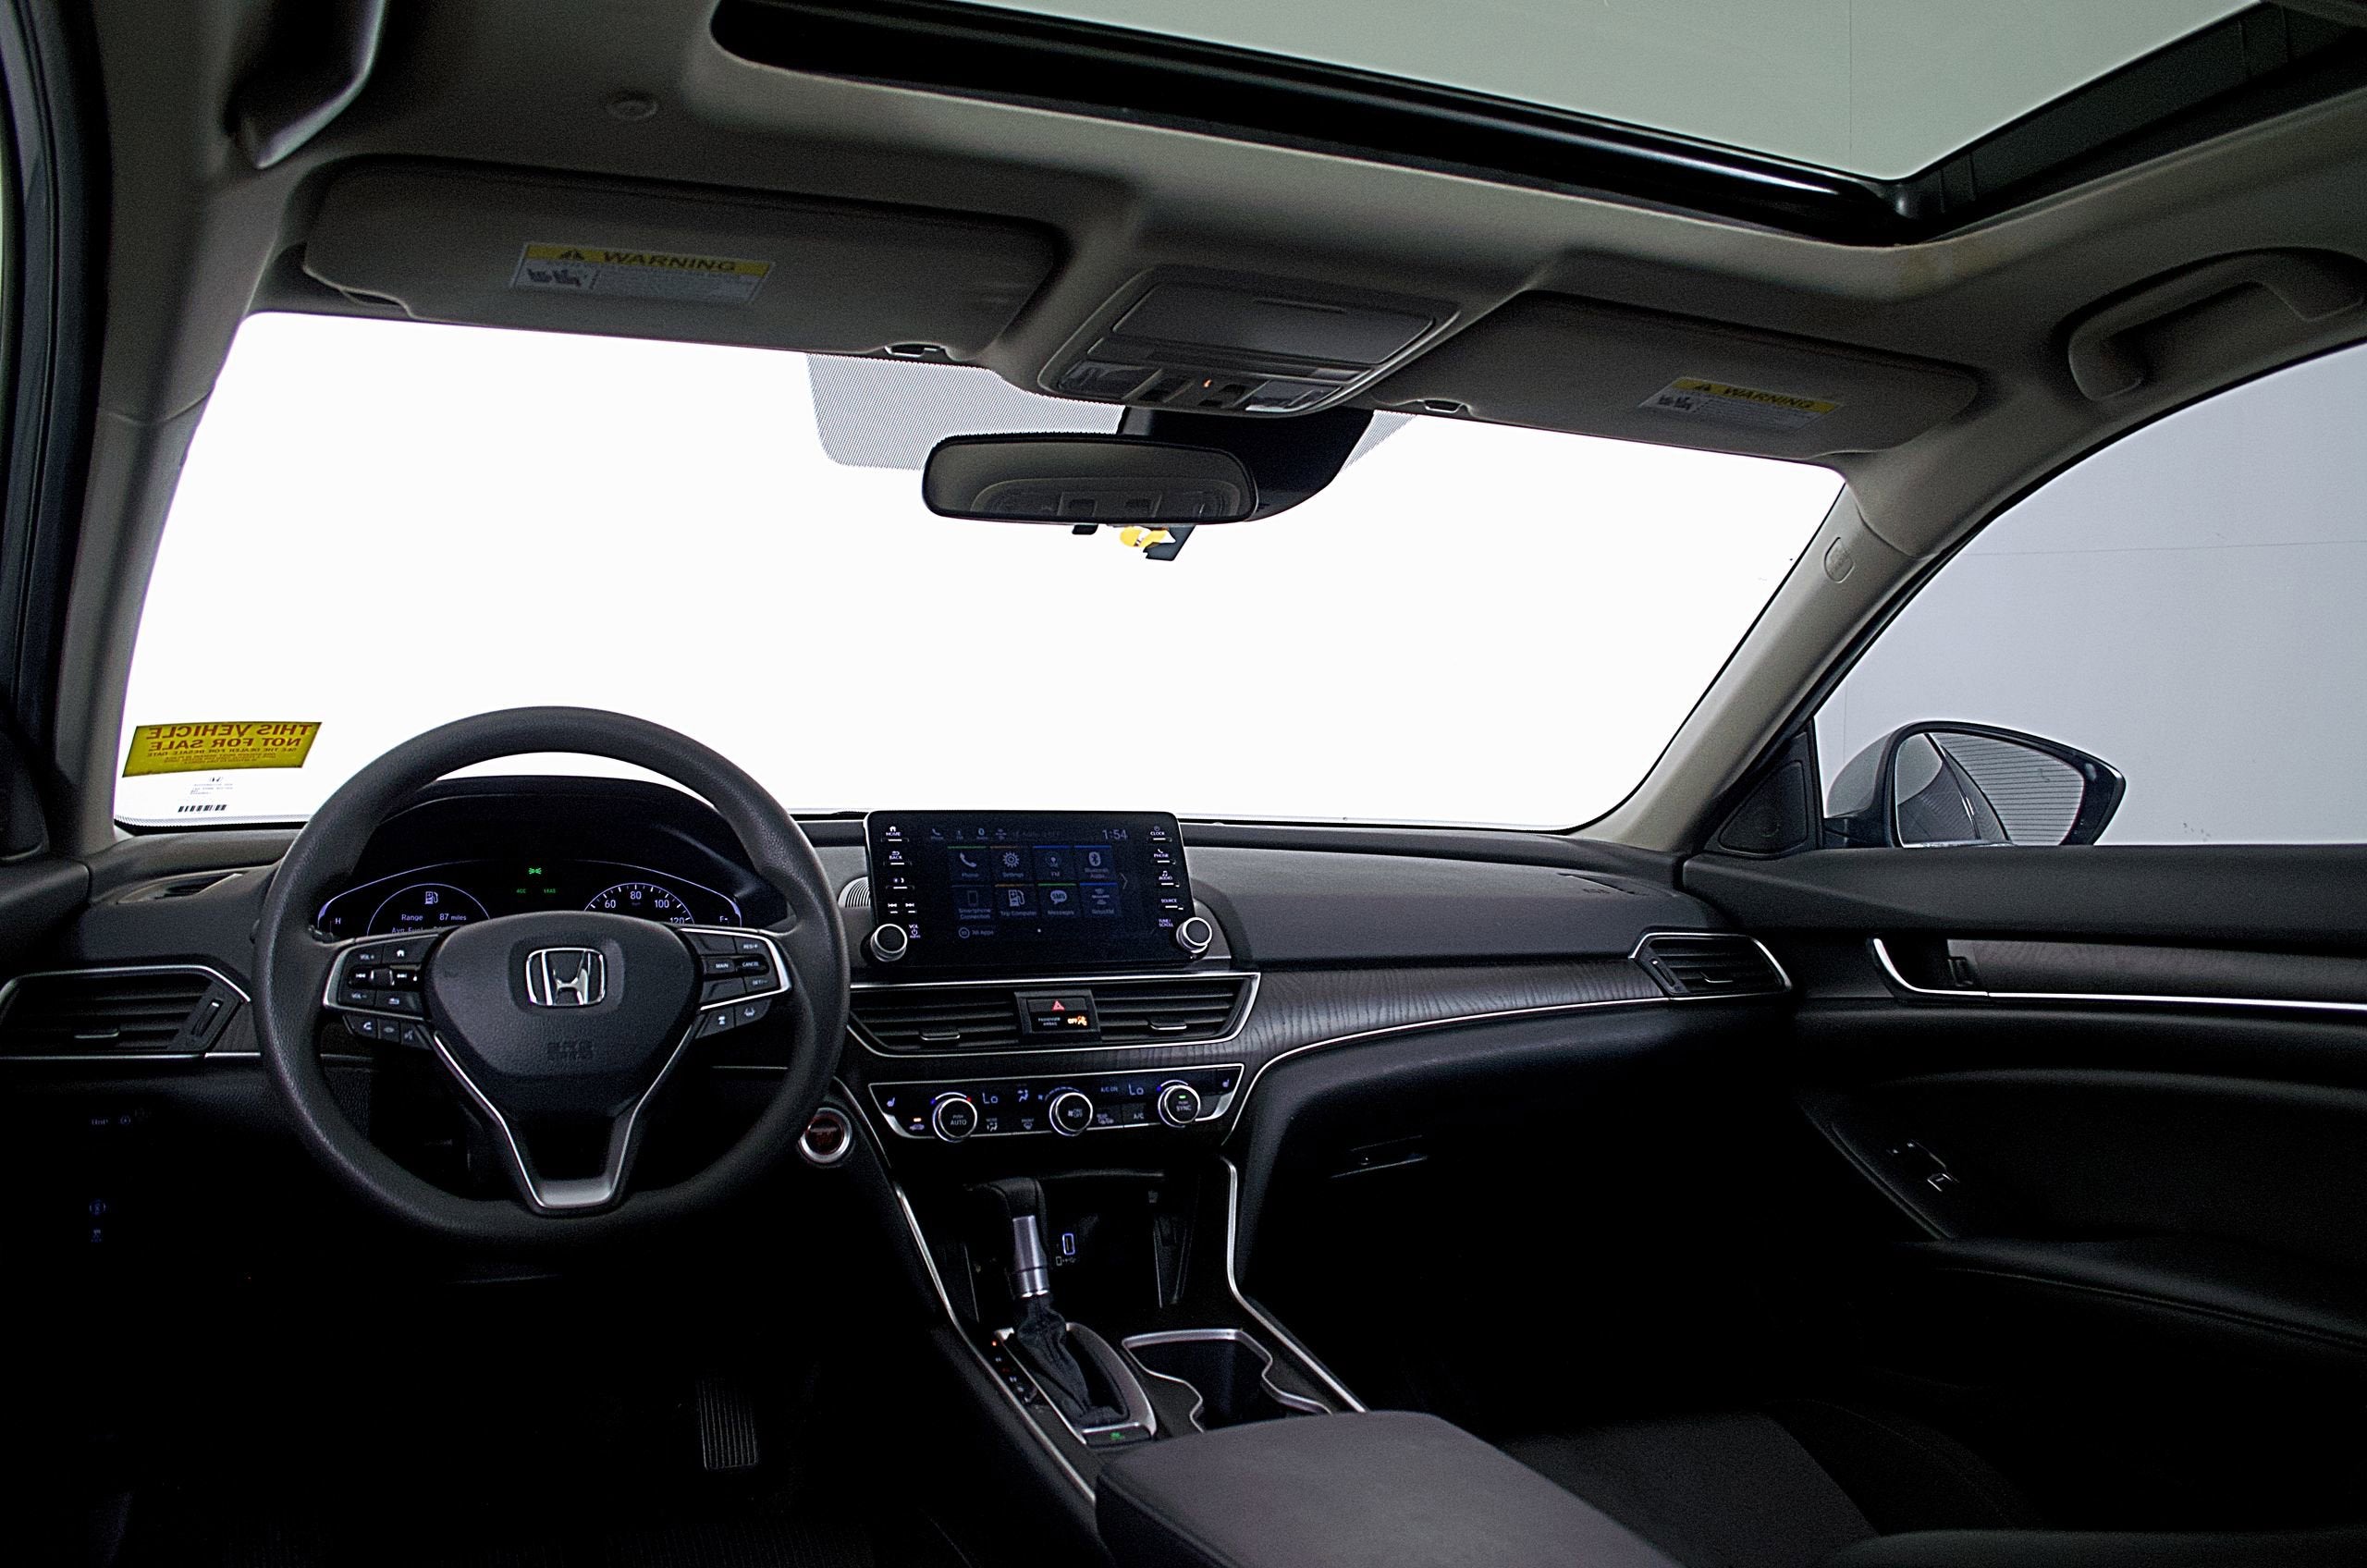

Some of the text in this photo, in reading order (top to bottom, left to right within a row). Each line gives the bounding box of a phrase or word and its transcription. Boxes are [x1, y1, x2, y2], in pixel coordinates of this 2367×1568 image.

[604, 251, 736, 272] WARNING
[1723, 386, 1814, 409] WARNING
[1102, 828, 1129, 840] 1:54
[630, 891, 642, 900] 80
[605, 900, 617, 909] 60
[655, 900, 669, 909] 100
[669, 916, 685, 925] 120
[1128, 1084, 1144, 1096] Lo
[982, 1093, 998, 1104] Lo
